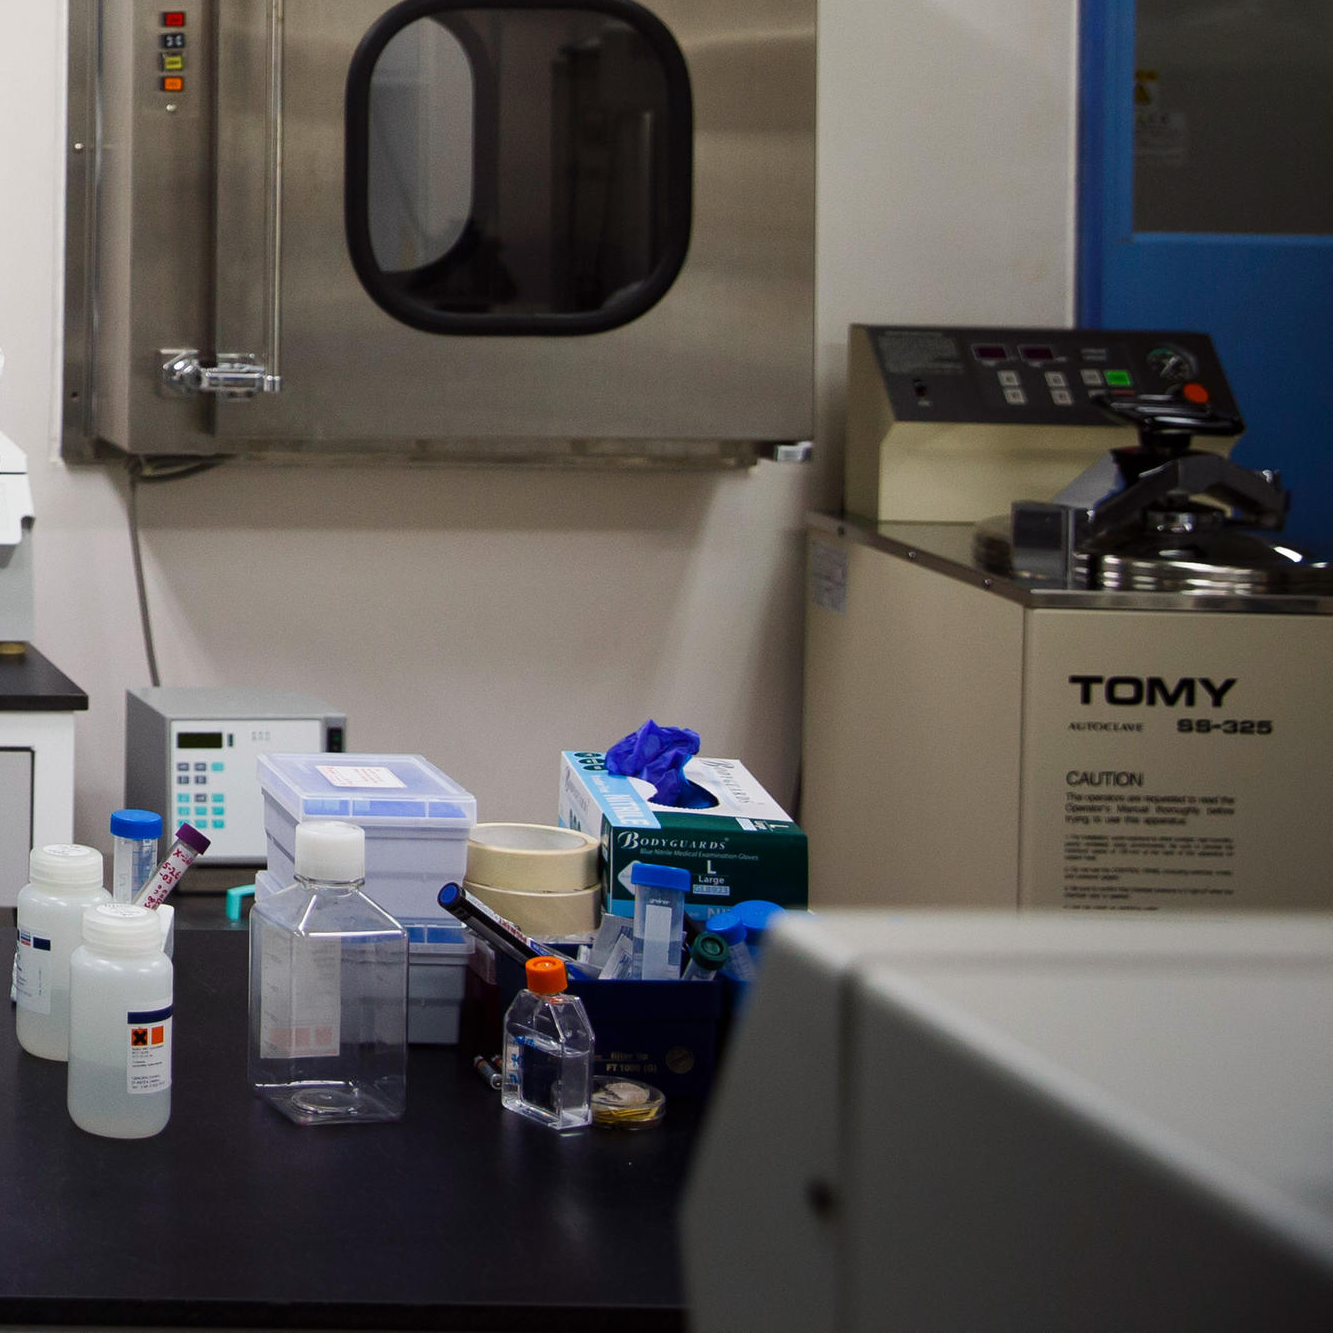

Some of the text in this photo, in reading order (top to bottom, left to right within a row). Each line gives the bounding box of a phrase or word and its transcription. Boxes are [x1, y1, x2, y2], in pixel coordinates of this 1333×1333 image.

[1068, 675, 1238, 708] TOMY
[1067, 718, 1274, 736] AUTOCLAVE SS-325
[1066, 770, 1144, 787] CAUTION
[617, 830, 727, 850] BODYGUARDS
[674, 849, 697, 858] Medical
[698, 850, 737, 859] Examination
[738, 852, 759, 861] Gloves
[706, 860, 717, 874] L
[698, 875, 725, 885] Large
